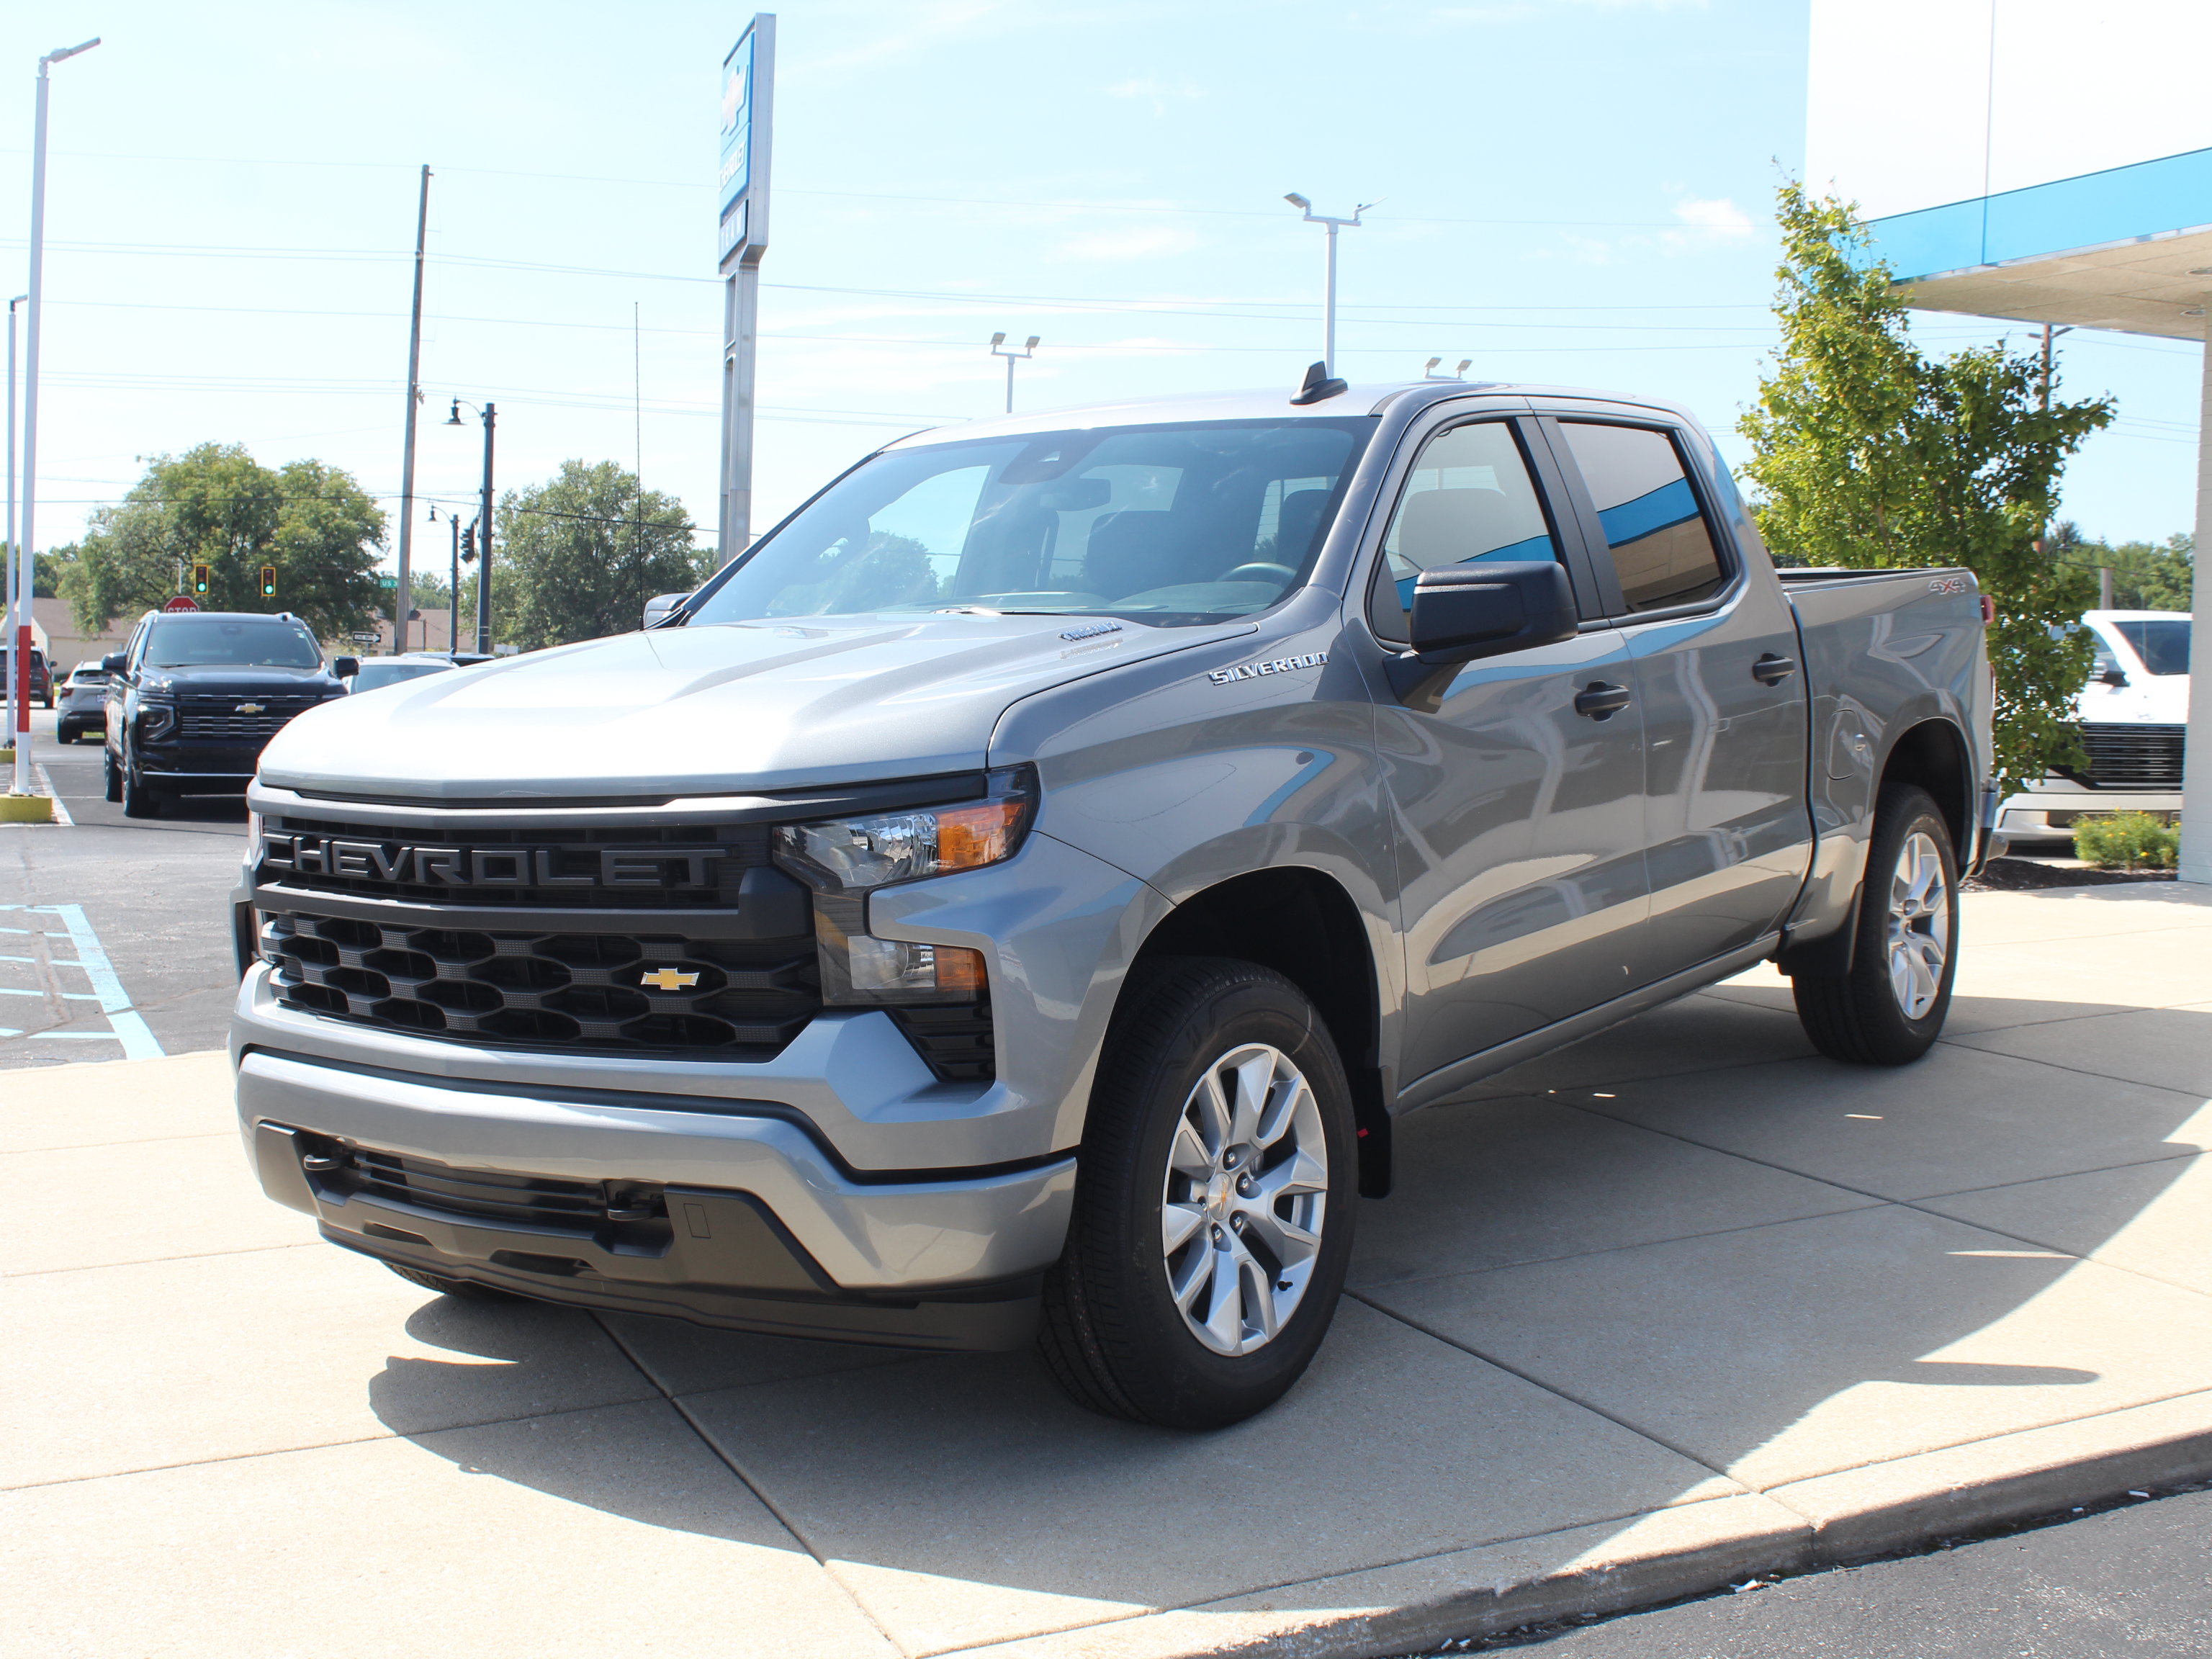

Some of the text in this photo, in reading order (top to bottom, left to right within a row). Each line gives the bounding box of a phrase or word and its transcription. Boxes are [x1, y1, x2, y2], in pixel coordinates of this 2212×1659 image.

[721, 210, 742, 254] TEAM
[1209, 651, 1329, 685] SILVERADO
[262, 832, 731, 888] CHEVROLET
